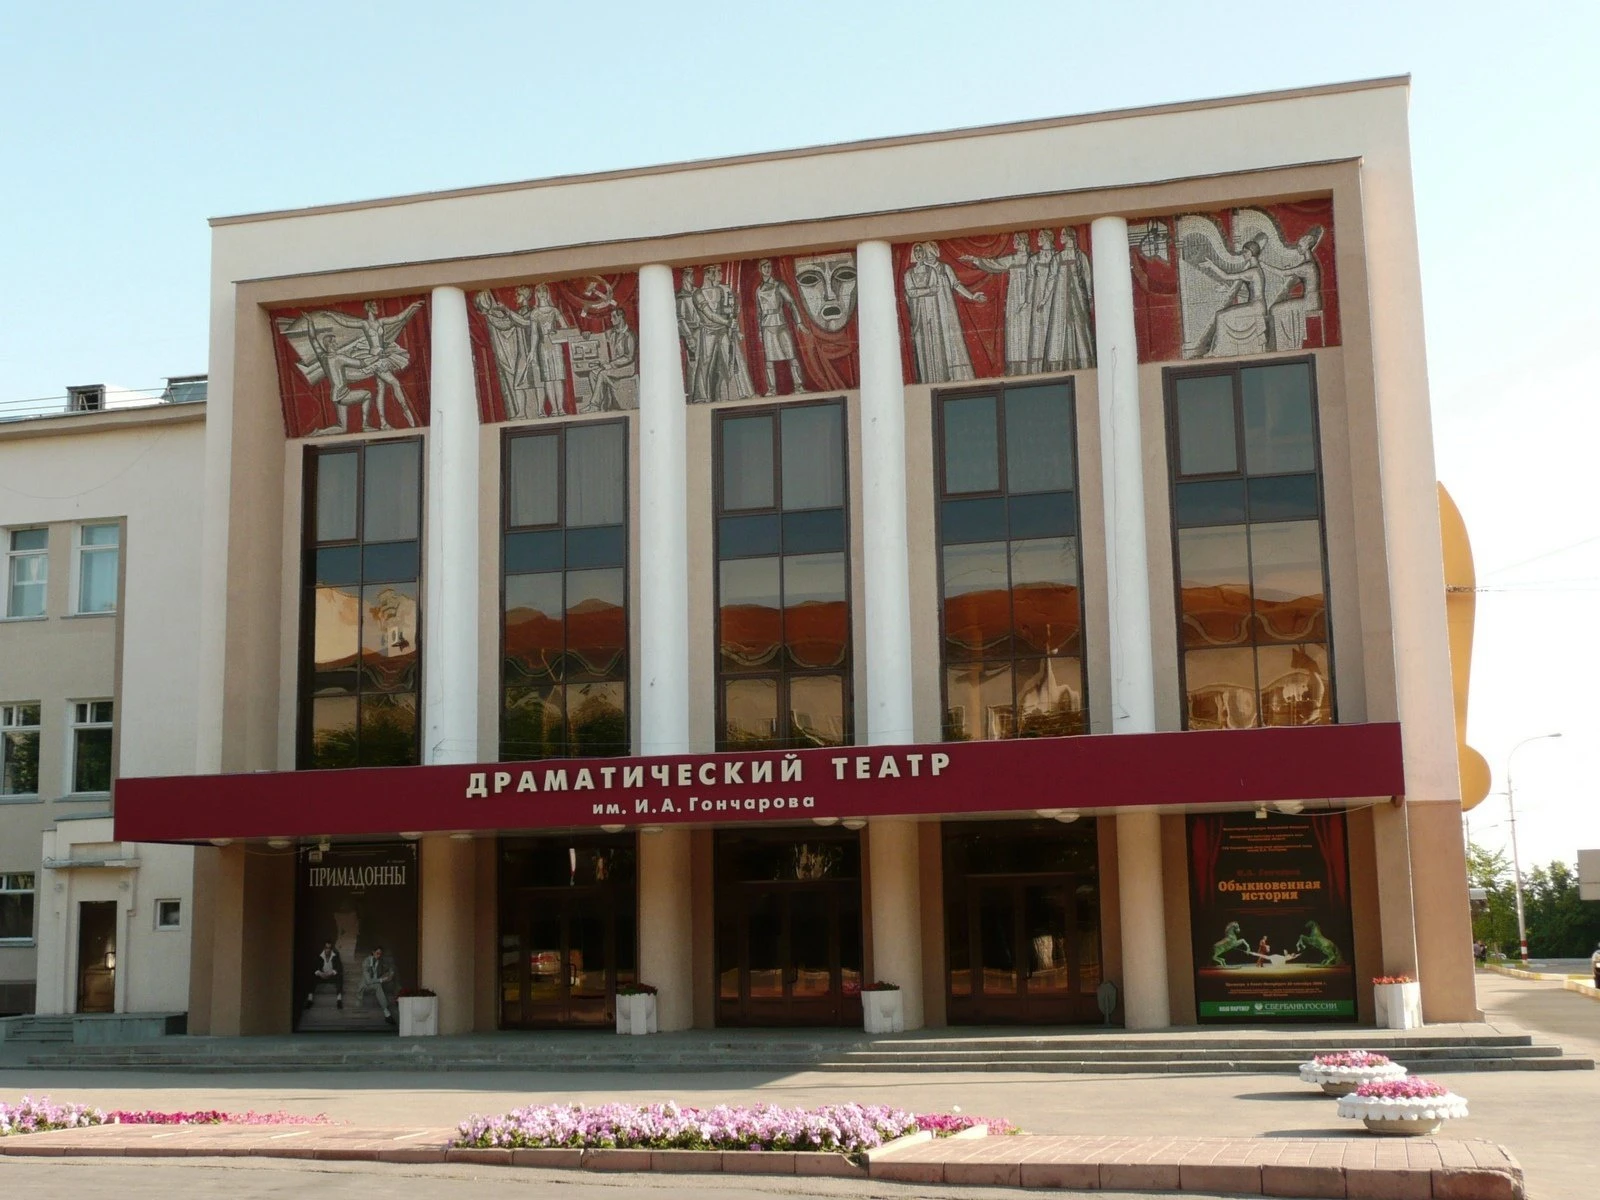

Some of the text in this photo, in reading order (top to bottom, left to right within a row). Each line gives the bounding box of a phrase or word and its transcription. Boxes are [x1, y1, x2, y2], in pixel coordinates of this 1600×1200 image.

[466, 753, 950, 798] ДРАМАТИЧЕСКИЙ ТЕАТР
[592, 803, 627, 815] им.
[689, 796, 815, 814] Гончарова
[309, 866, 406, 889] ПРИМАДОННЫ
[1218, 880, 1321, 892] Обыкновенная
[1241, 891, 1298, 902] история
[1264, 1002, 1338, 1011] СБЕРБАНК РОССИИ
